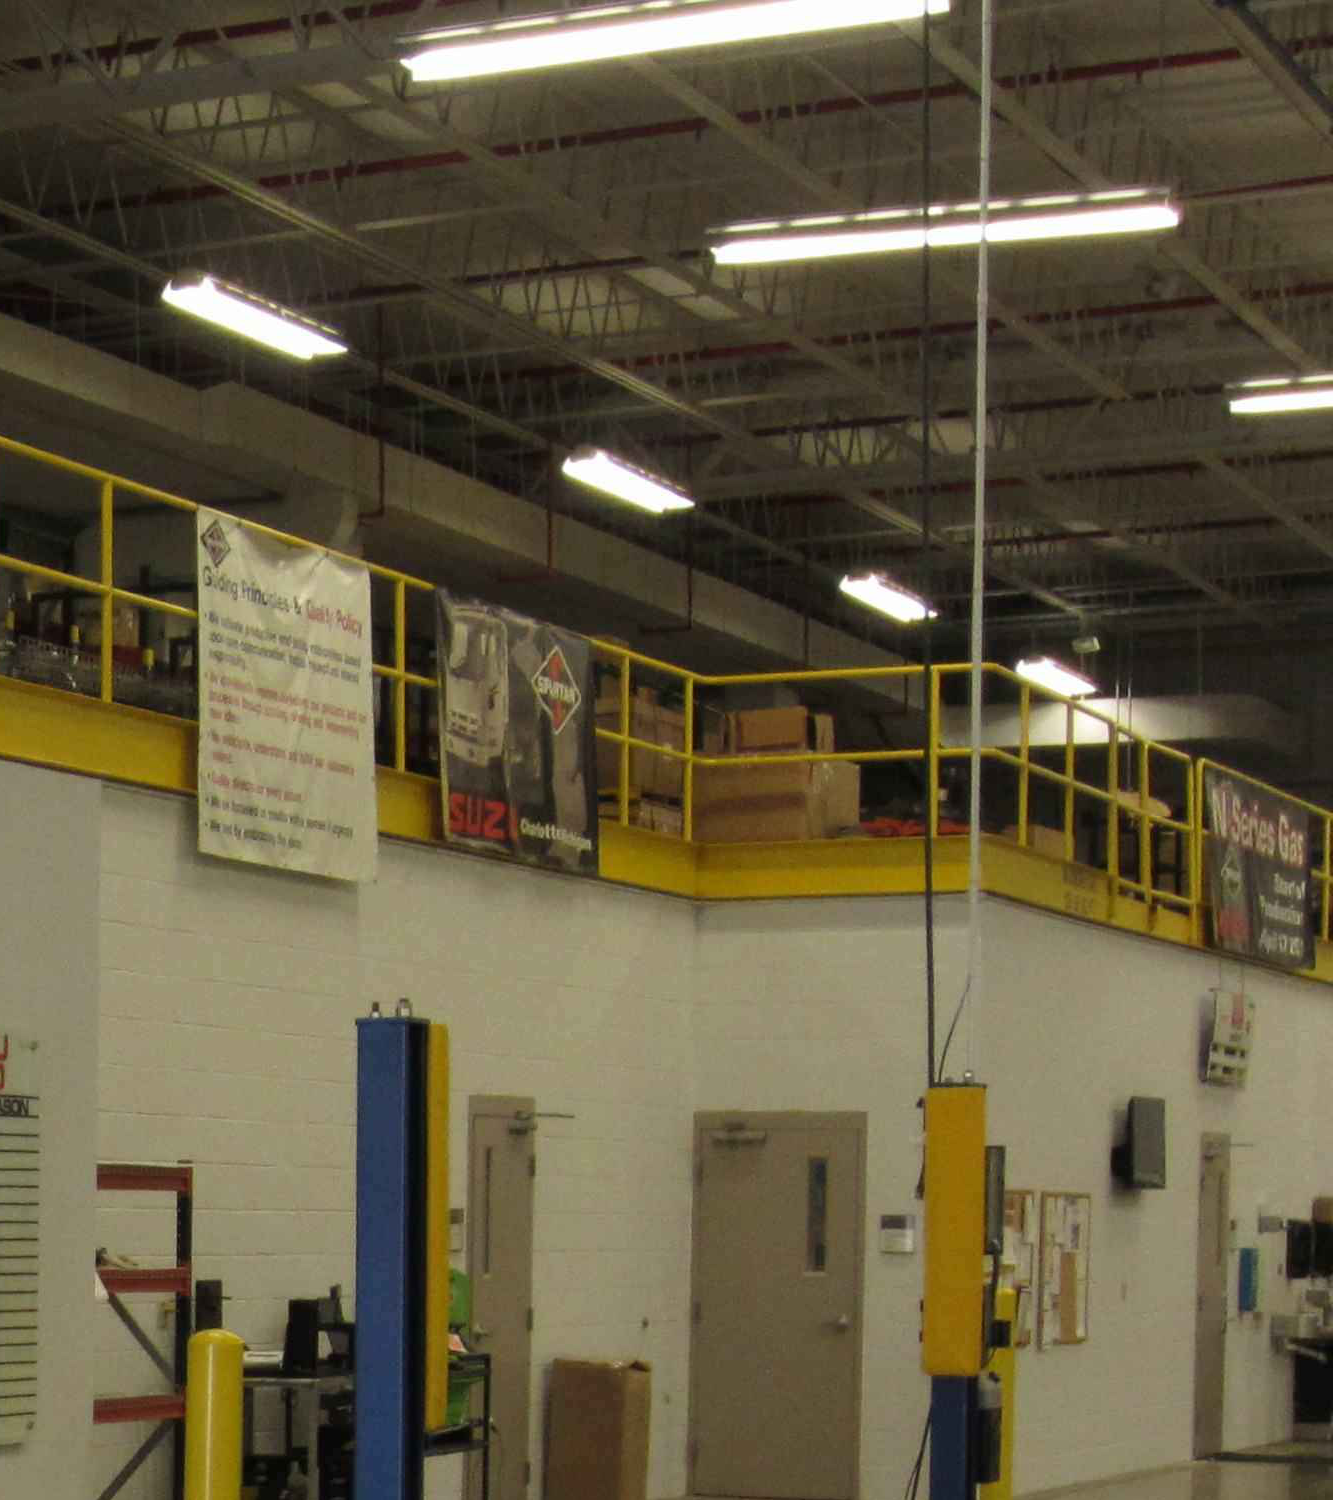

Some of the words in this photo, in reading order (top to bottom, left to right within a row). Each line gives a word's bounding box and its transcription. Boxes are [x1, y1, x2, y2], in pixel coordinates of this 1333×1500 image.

[336, 609, 362, 638] Policy
[537, 675, 575, 704] SPARTAN
[1278, 813, 1305, 868] Gas
